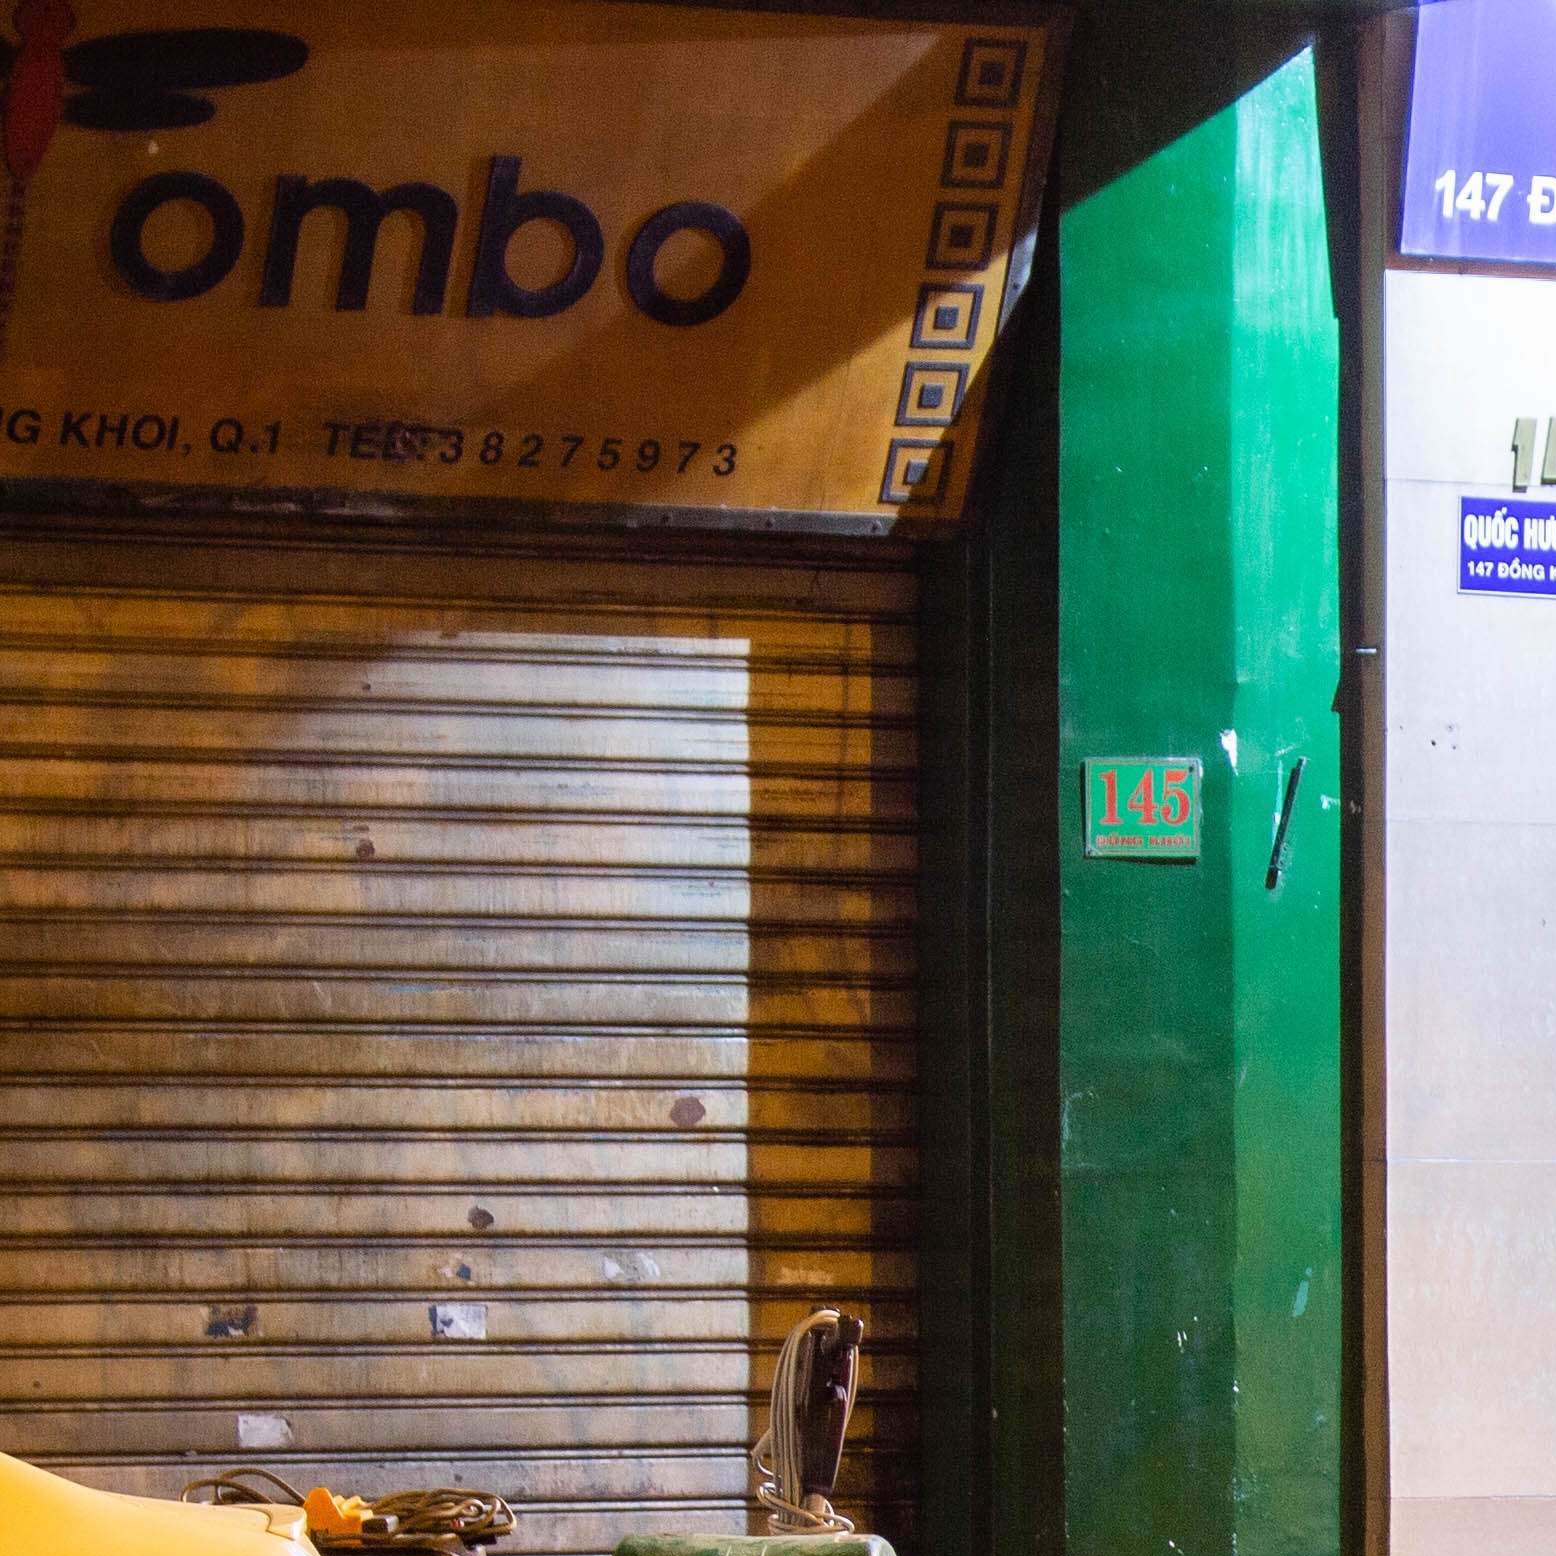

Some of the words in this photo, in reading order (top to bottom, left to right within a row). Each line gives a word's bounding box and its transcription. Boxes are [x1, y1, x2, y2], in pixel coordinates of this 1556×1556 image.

[1434, 169, 1515, 223] 147
[1463, 507, 1519, 549] QUỐC
[1467, 560, 1494, 577] 147
[1498, 556, 1545, 579] ĐỒNG
[1098, 769, 1191, 825] 145
